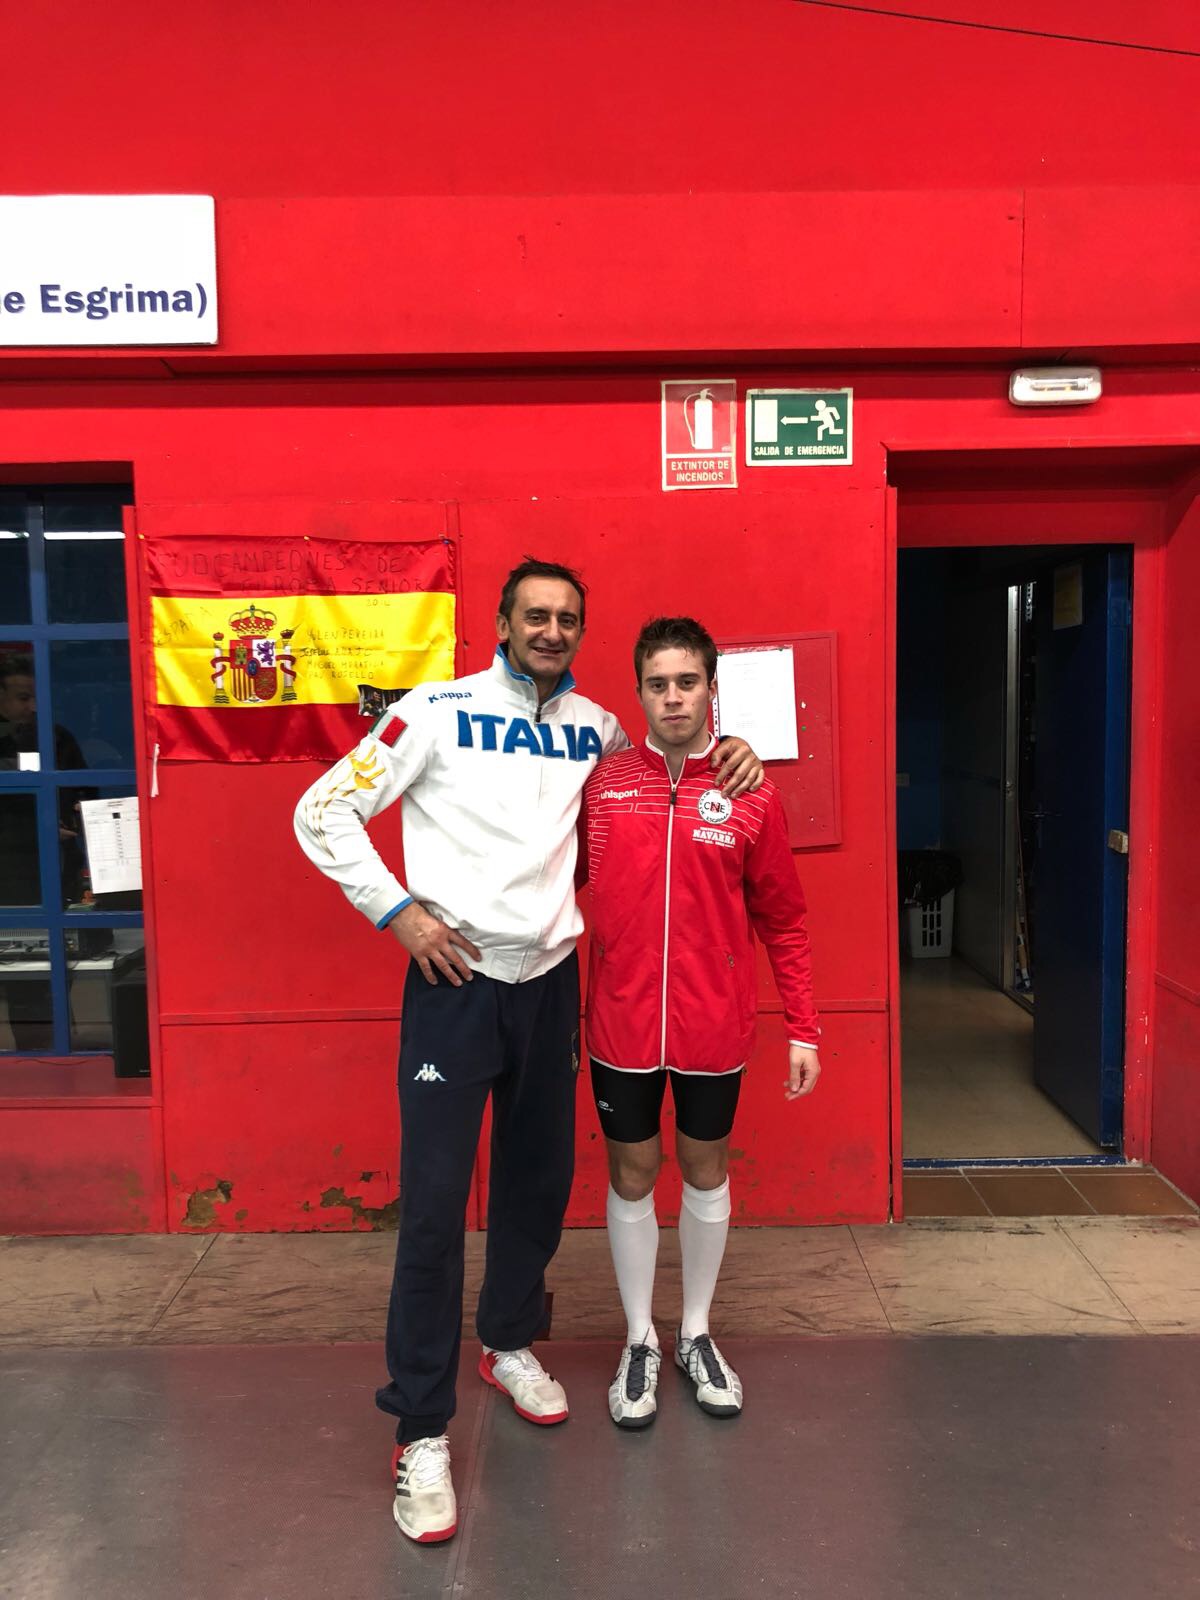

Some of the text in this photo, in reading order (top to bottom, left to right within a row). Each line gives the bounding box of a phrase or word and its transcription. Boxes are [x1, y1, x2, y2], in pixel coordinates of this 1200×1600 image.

[0, 283, 207, 320] e Esgrima)
[754, 445, 844, 456] SALIDA DE EMERGENCIA
[671, 460, 729, 470] EXTINTOR DE
[676, 471, 723, 481] INCENDIOS
[377, 556, 402, 573] DE
[428, 690, 472, 704] Kappa
[457, 710, 602, 761] ITALIA
[600, 788, 639, 800] uhlsport
[692, 829, 736, 846] NAVARRA
